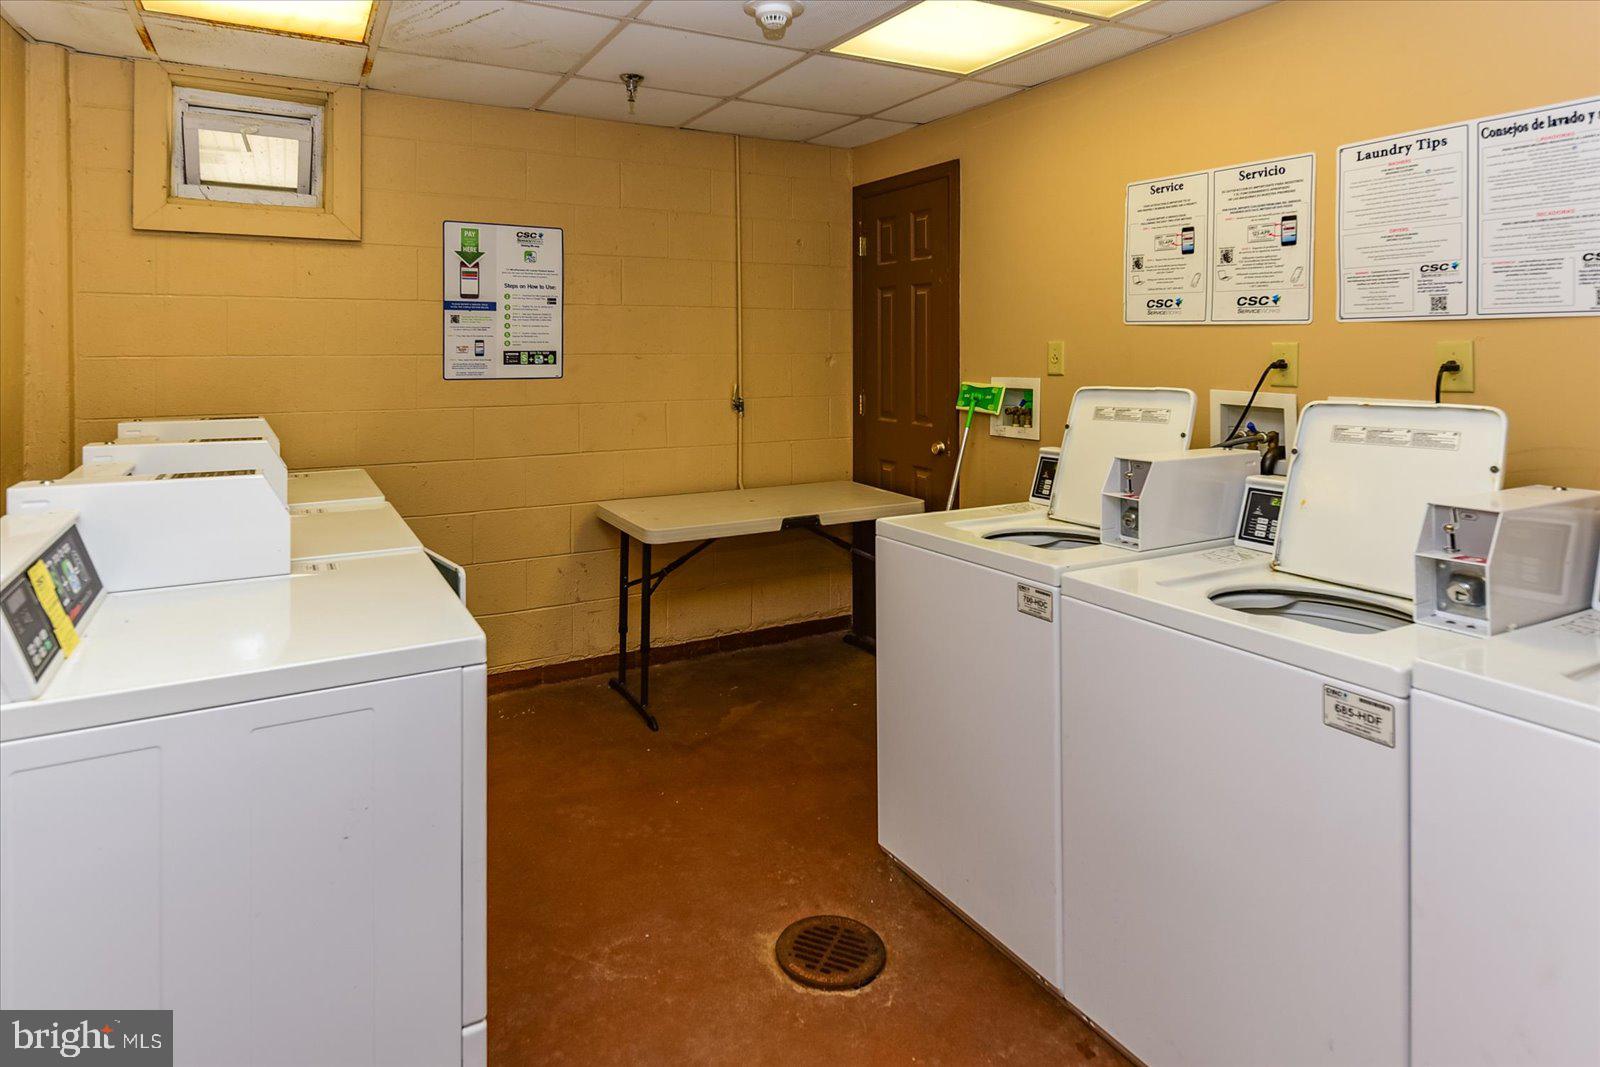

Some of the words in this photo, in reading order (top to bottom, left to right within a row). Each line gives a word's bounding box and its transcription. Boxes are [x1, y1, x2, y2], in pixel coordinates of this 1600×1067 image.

[1481, 122, 1529, 140] Consejos
[1532, 117, 1545, 131] de
[1547, 110, 1585, 128] lavado
[1588, 111, 1595, 125] y
[1356, 143, 1413, 162] Laundry
[1416, 137, 1448, 152] Tips
[1238, 165, 1286, 181] Servicio
[1150, 182, 1184, 195] Service
[516, 231, 537, 239] CSC
[1420, 262, 1450, 273] CSC
[504, 282, 518, 290] Steps
[1146, 298, 1174, 309] CSC
[1236, 295, 1270, 306] CSC
